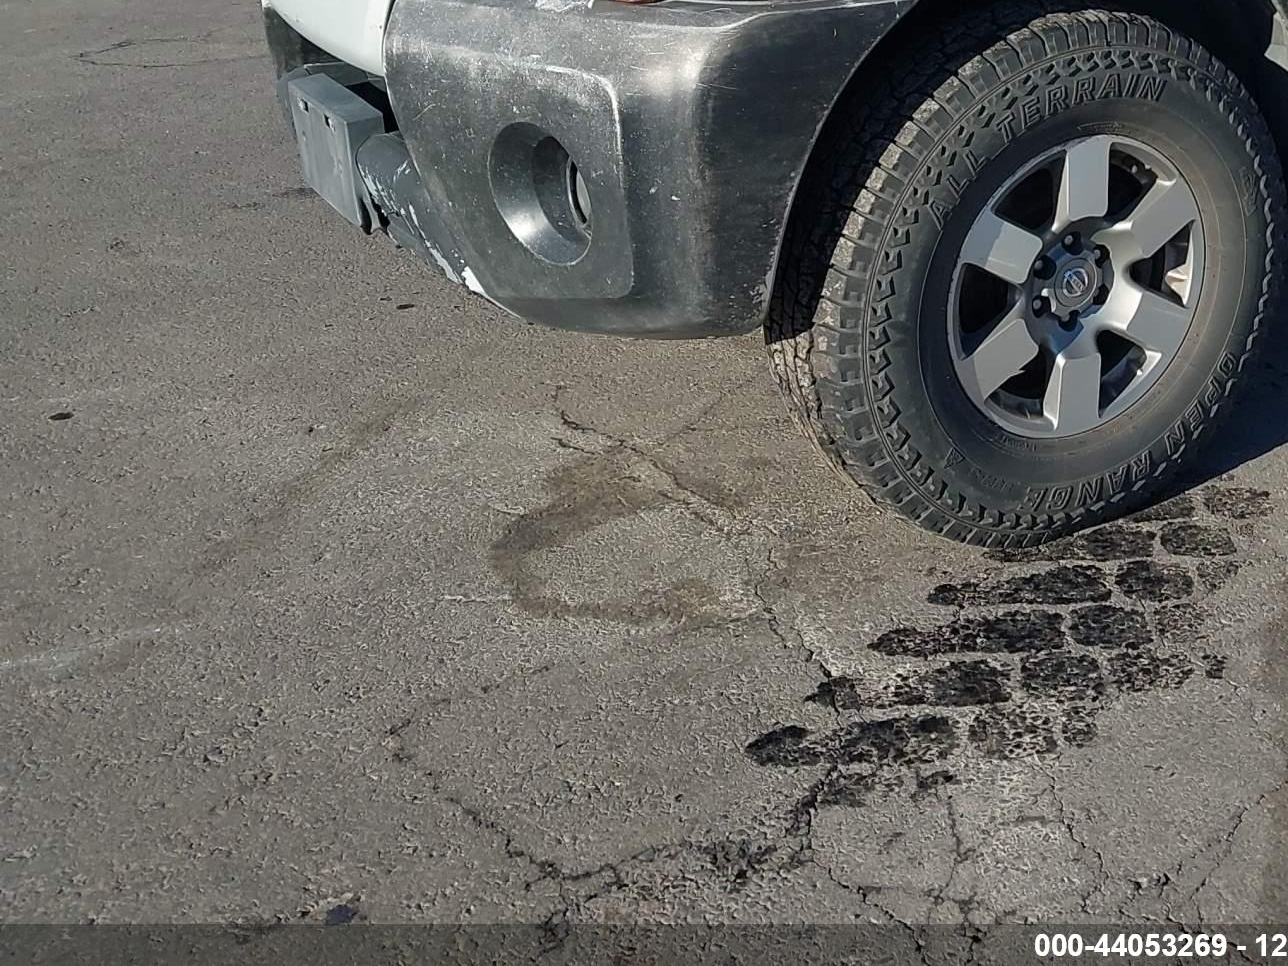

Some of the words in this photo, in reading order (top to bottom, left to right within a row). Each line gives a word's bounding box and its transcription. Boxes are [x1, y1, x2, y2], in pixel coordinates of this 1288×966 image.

[928, 148, 988, 232] ALL
[995, 72, 1168, 145] TERRAIN
[1164, 352, 1238, 458] OPEN
[1018, 450, 1152, 512] RANGE
